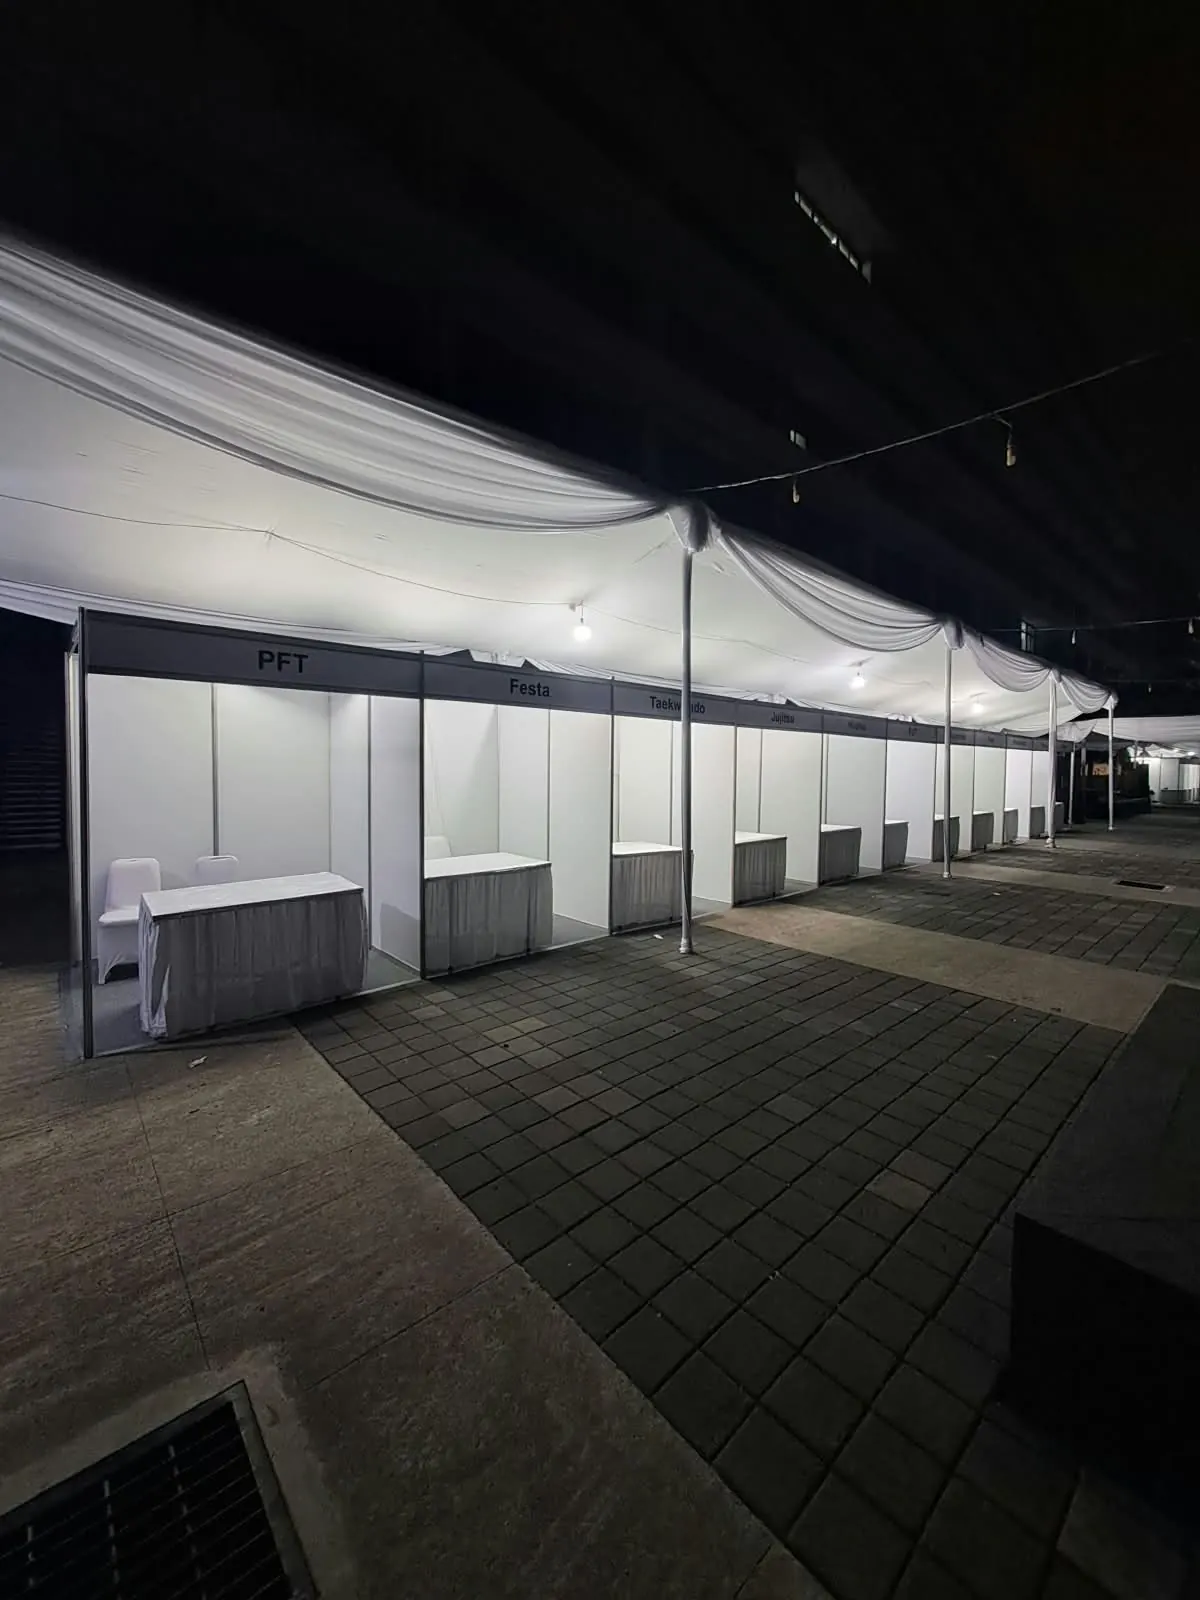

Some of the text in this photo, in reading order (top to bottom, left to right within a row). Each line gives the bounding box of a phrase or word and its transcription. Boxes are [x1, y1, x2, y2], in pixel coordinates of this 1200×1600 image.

[258, 649, 309, 674] PFT
[510, 678, 550, 697] Festa
[649, 695, 706, 714] Taekwdo
